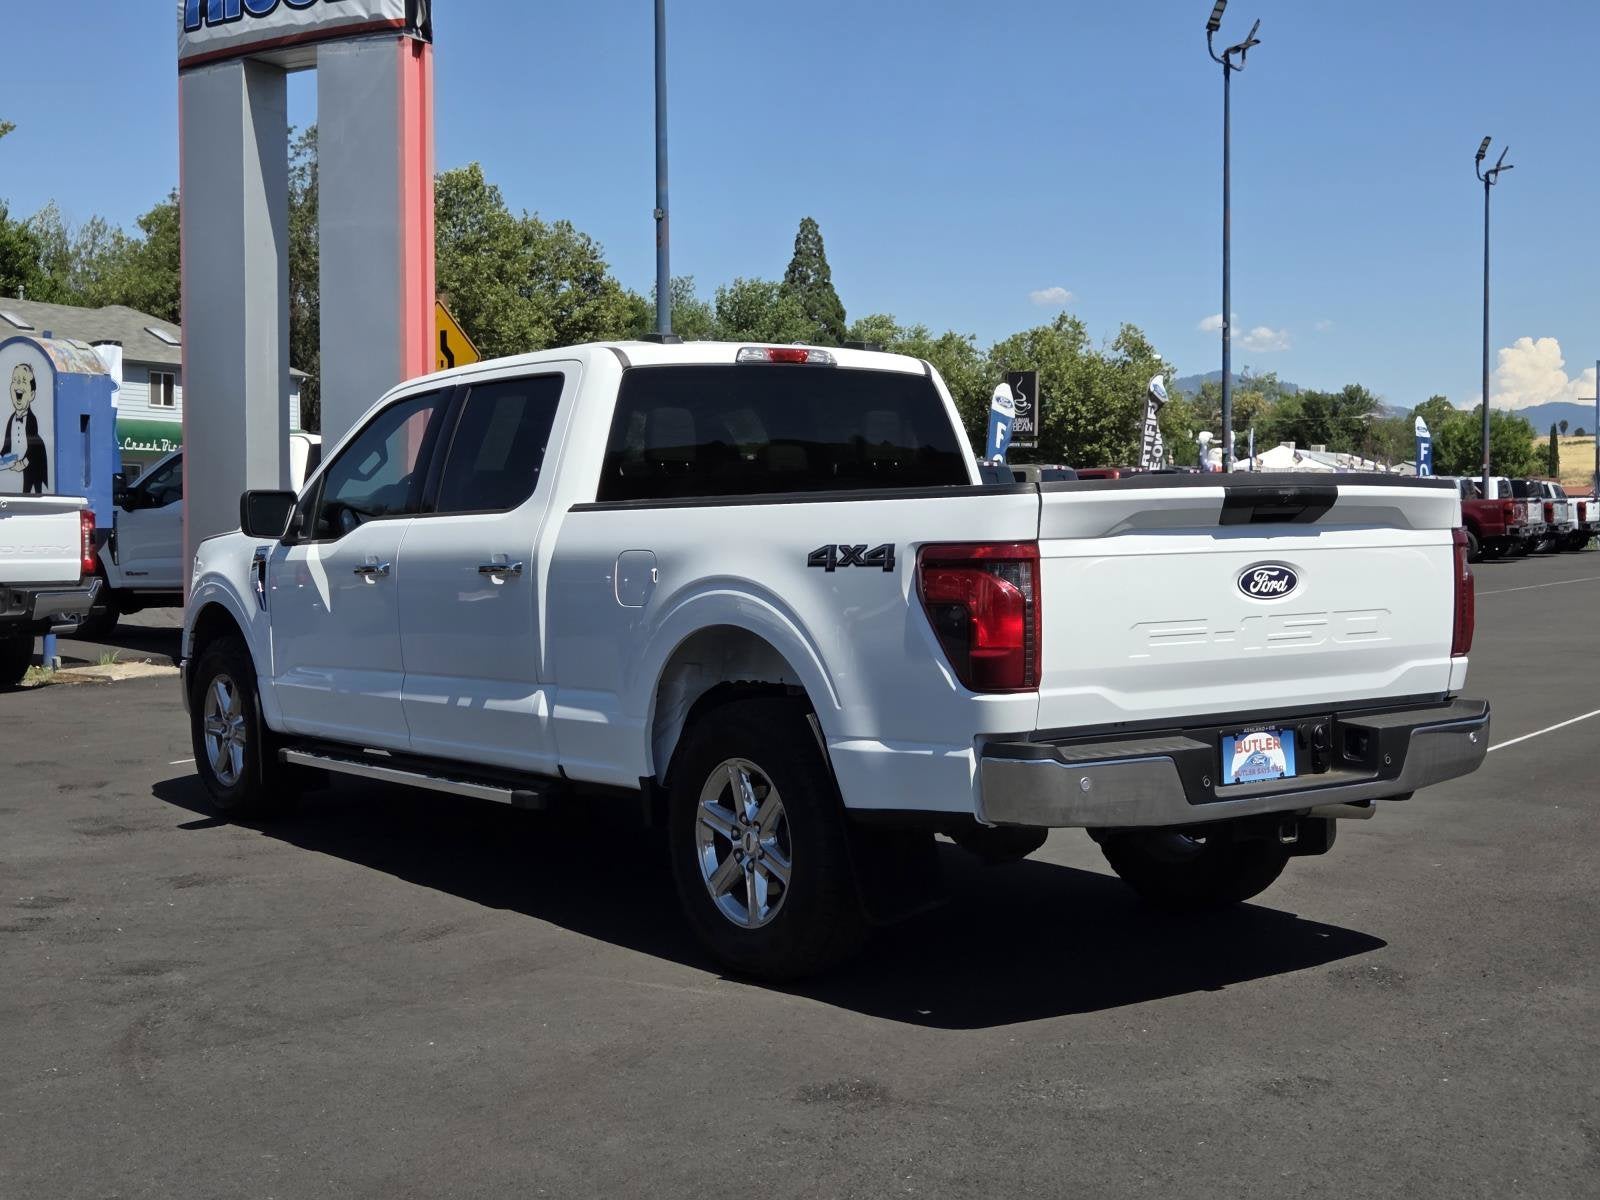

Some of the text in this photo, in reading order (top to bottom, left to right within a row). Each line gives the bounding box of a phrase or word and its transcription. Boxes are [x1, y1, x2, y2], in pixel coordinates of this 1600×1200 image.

[124, 437, 161, 452] Creek
[1250, 570, 1288, 593] Ford
[1129, 608, 1392, 658] F-150
[1236, 737, 1280, 753] BUTLER
